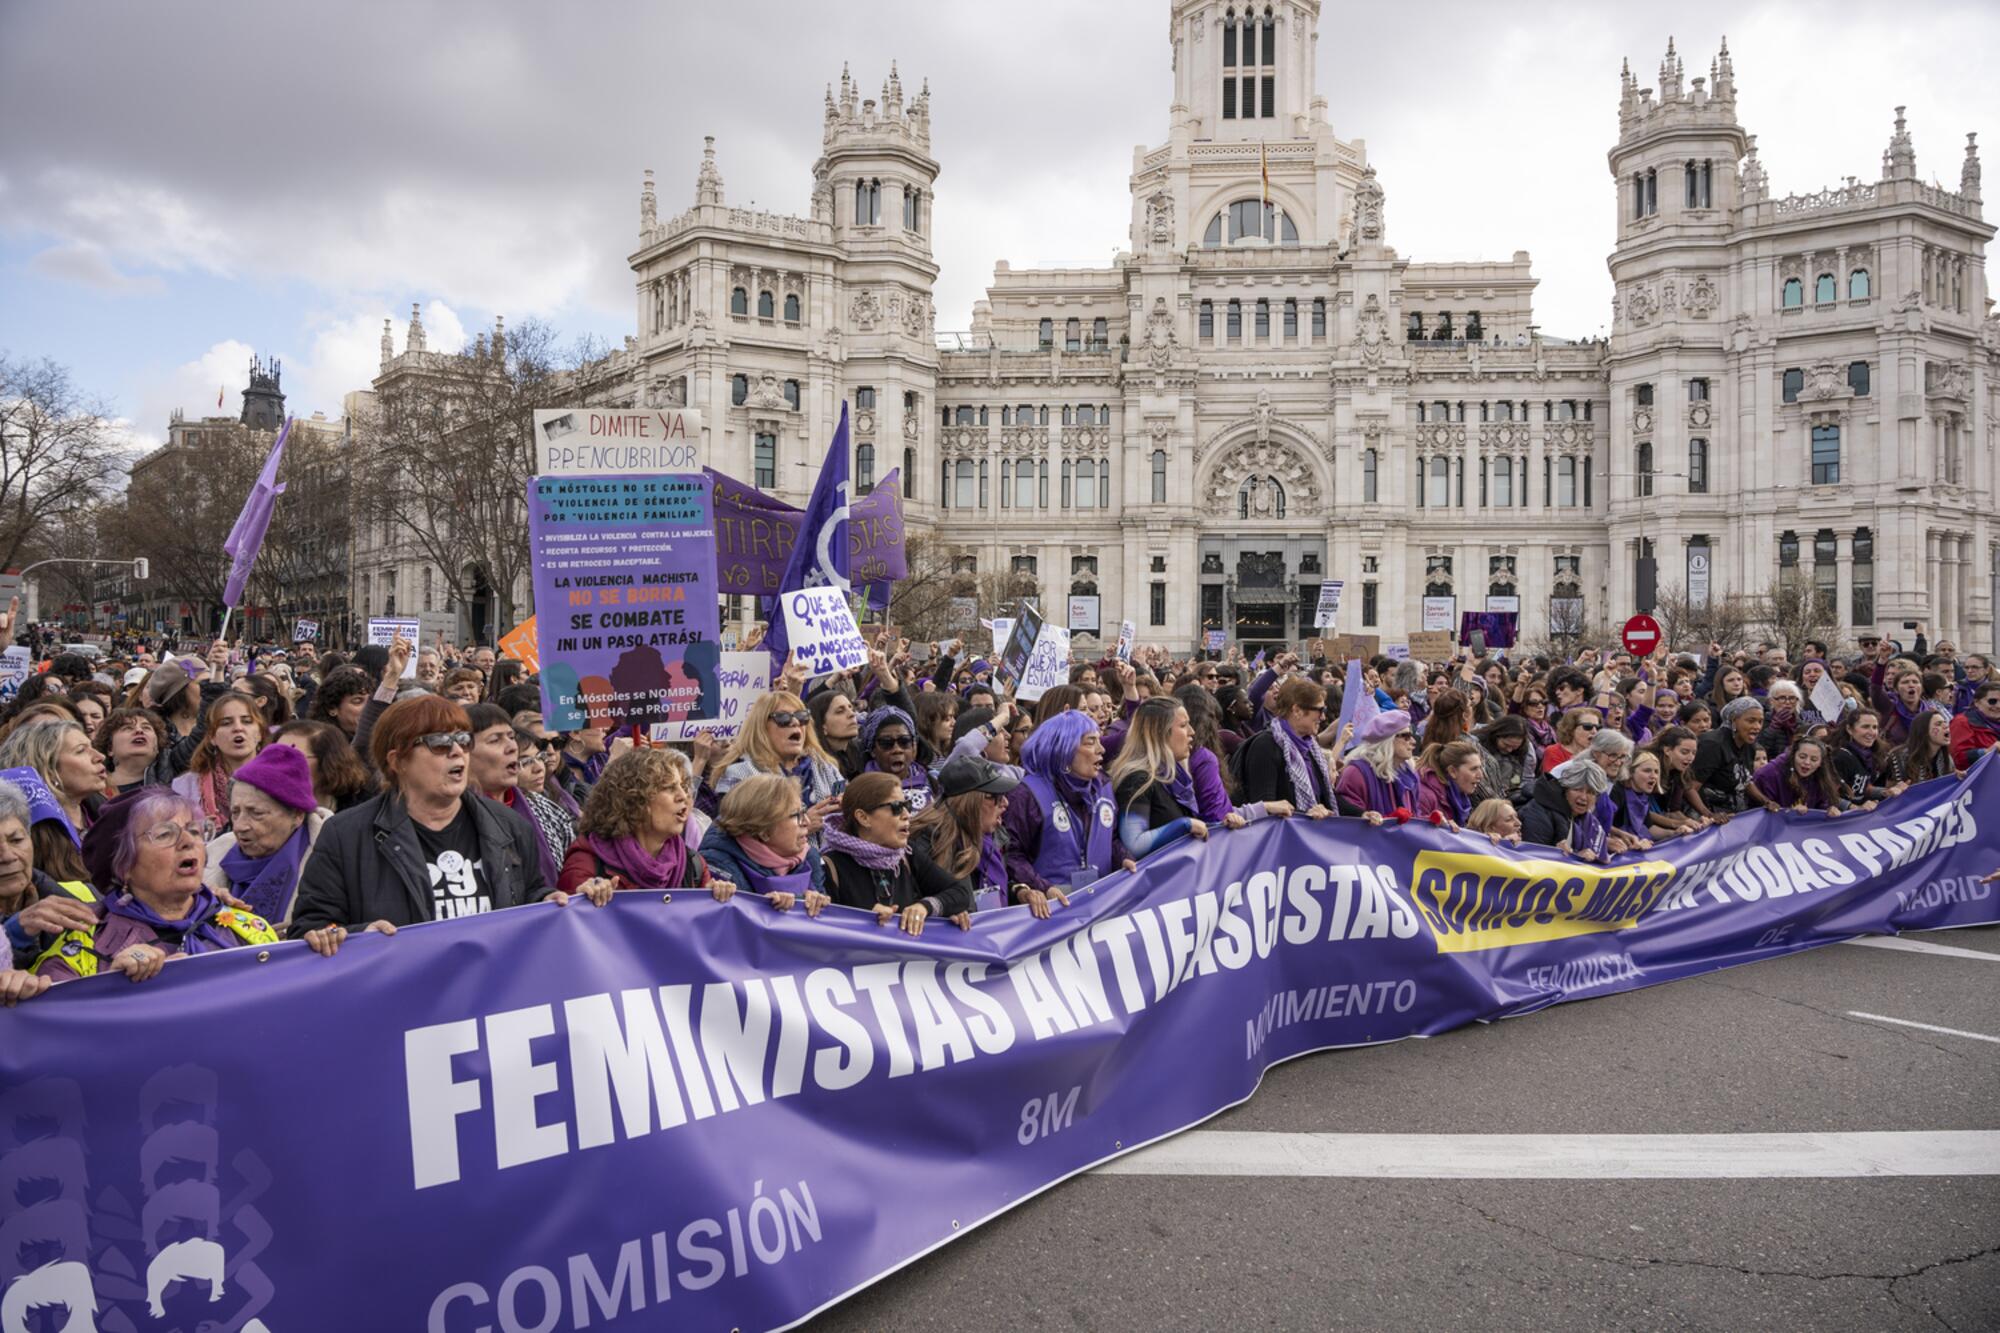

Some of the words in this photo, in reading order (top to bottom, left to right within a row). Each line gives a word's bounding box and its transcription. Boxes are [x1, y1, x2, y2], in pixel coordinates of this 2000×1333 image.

[590, 414, 650, 438] DIMITE
[576, 444, 697, 469] ENCUBRIDOR
[538, 486, 551, 495] EN
[559, 483, 617, 494] MÓSTOLES
[623, 484, 637, 493] NO
[643, 484, 656, 492] SE
[663, 483, 703, 492] CAMBIA
[624, 498, 638, 506] DE
[544, 514, 566, 522] POR
[590, 533, 599, 541] LA
[601, 532, 637, 540] VIOLENCIA
[641, 531, 669, 539] CONTRA
[671, 530, 681, 538] LA
[546, 547, 579, 555] RECORTA
[581, 546, 617, 554] RECURSOS
[546, 561, 556, 569] ES
[558, 560, 568, 568] UN
[570, 559, 611, 567] RETROCESO
[554, 577, 570, 588] LA
[574, 575, 634, 587] VIOLENCIA
[642, 572, 699, 584] MACHISTA
[569, 591, 592, 606] NO
[600, 589, 621, 604] SE
[628, 586, 685, 603] BORRA
[570, 613, 592, 630] SE
[600, 609, 684, 628] COMBATE
[793, 593, 826, 627] QUE
[820, 613, 854, 637] MUJER
[583, 636, 602, 649] UN
[607, 634, 643, 648] PASO
[649, 628, 702, 646] ATRÁS!
[797, 643, 816, 660] NO
[819, 639, 842, 656] NOS
[814, 657, 833, 674] LA
[559, 695, 574, 705] En
[577, 690, 630, 703] Móstoles
[633, 690, 645, 699] se
[649, 686, 704, 698] NOMBRA,
[568, 711, 581, 720] se
[584, 706, 627, 719] LUCHA,
[631, 706, 643, 715] se
[646, 701, 701, 714] PROTEGE.
[404, 961, 1015, 1190] FEMINISTAS
[1008, 864, 1419, 1040] ANTIFASCISTAS
[1416, 868, 1586, 935] SOMOS
[1707, 838, 1856, 904] TODAS
[1838, 788, 1977, 878] PARTES
[427, 1179, 823, 1333] COMISIÓN
[1017, 1085, 1082, 1146] 8M
[1246, 978, 1417, 1061] MOVIMIENTO
[1527, 952, 1645, 994] FEMINISTA
[1755, 922, 1794, 947] DE
[1896, 874, 1991, 914] MADRID
